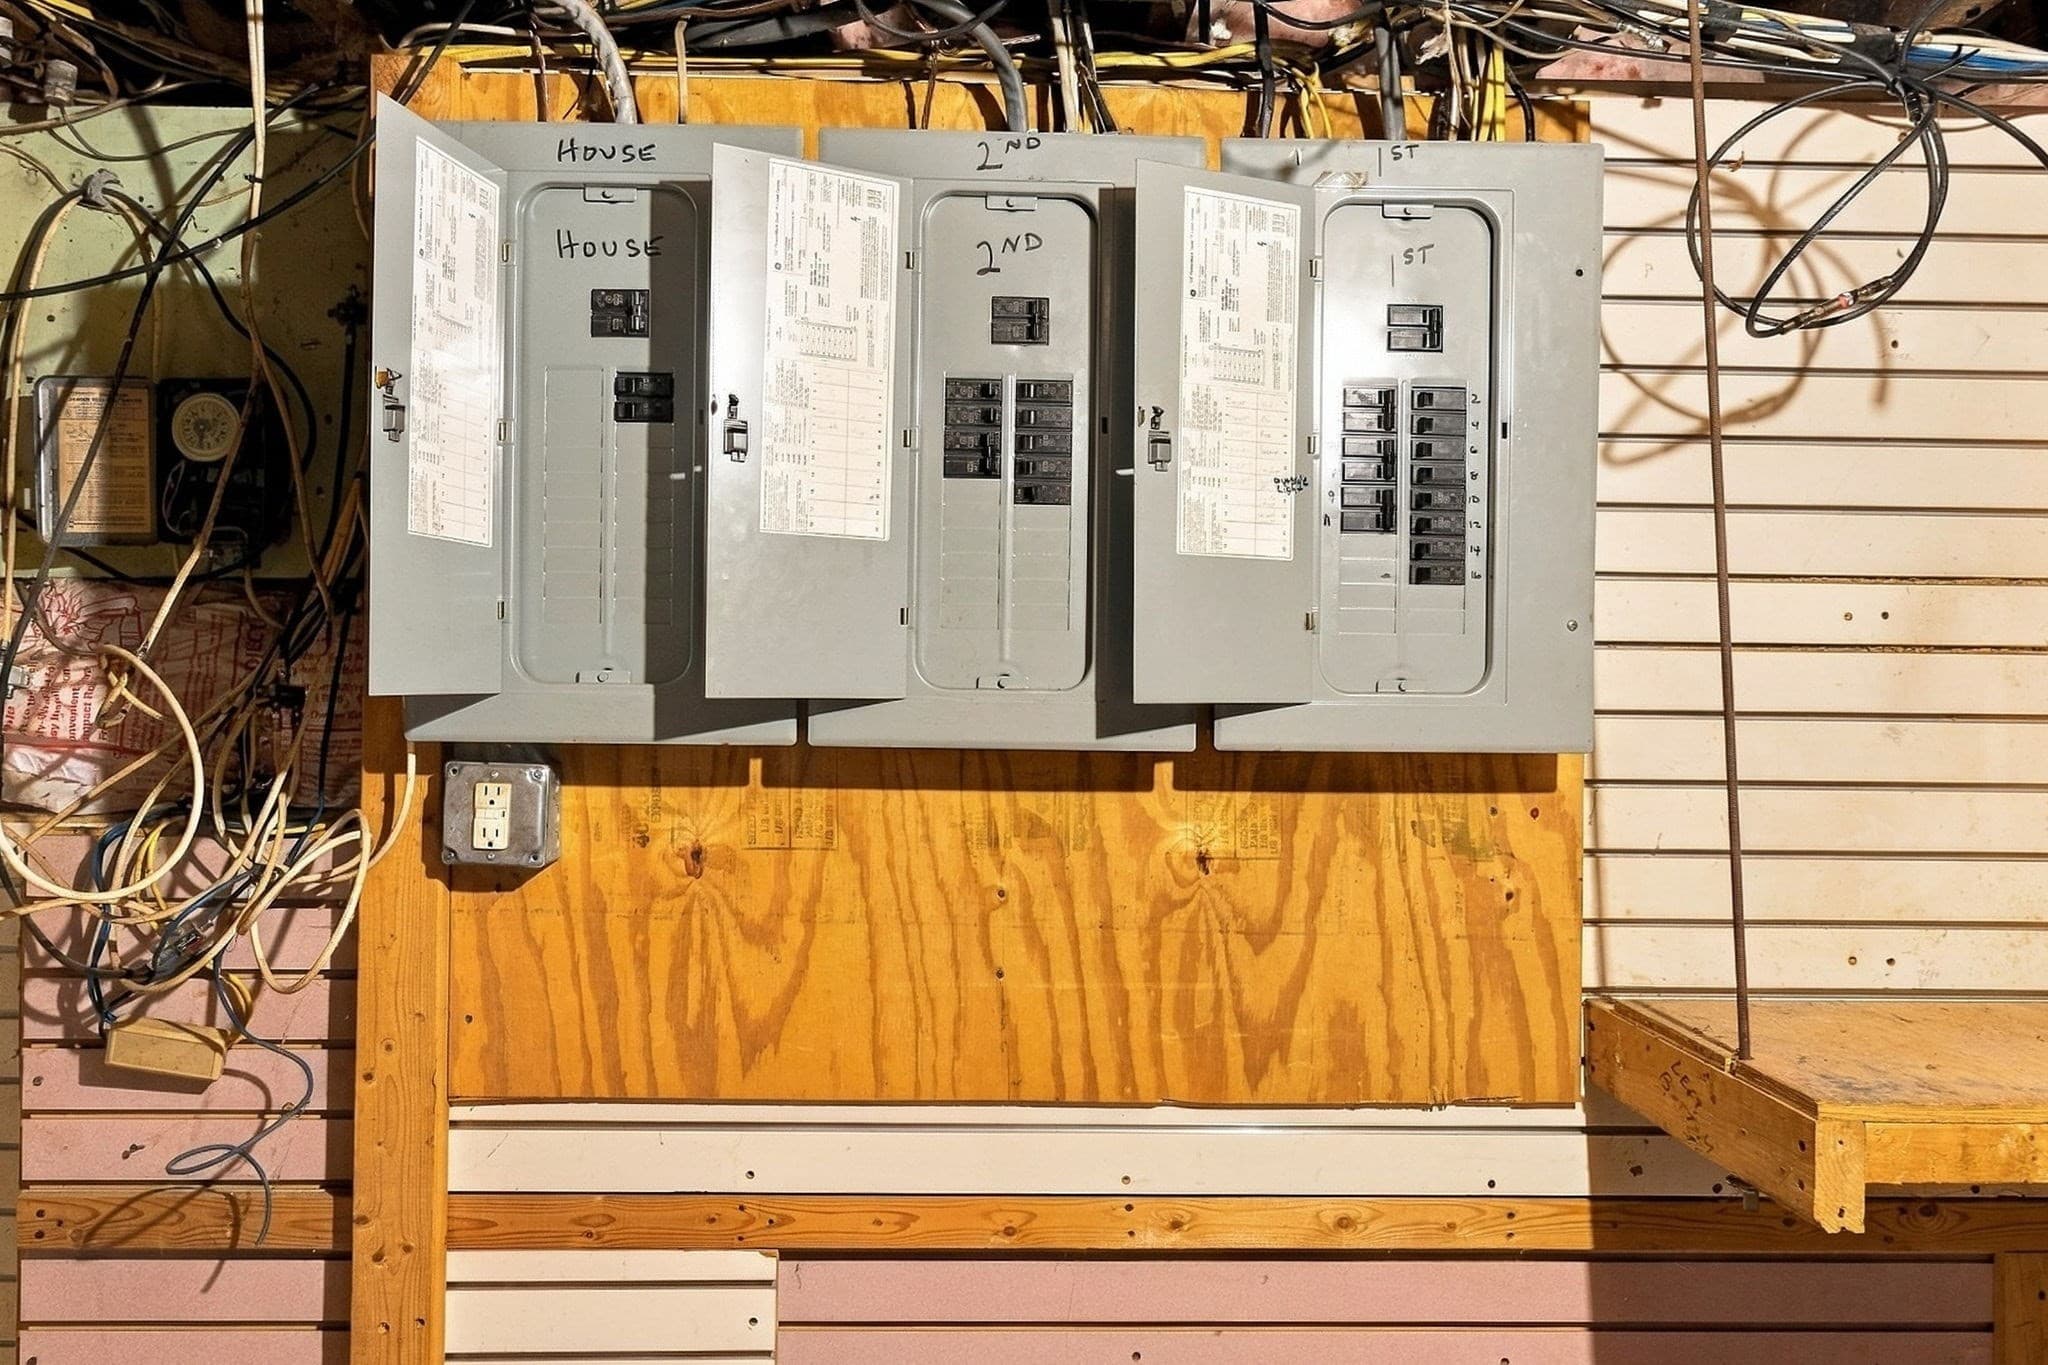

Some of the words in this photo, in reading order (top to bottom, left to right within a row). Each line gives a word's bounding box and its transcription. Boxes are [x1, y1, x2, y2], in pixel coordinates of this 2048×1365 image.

[557, 137, 657, 163] HOUSE
[555, 228, 665, 259] HOUSE
[1471, 393, 1481, 404] 2
[1471, 421, 1480, 431] 4
[1469, 445, 1479, 455] 6
[1470, 471, 1479, 481] 8
[1468, 495, 1480, 504] 10
[1468, 520, 1481, 529] 12
[1470, 545, 1481, 557] 14
